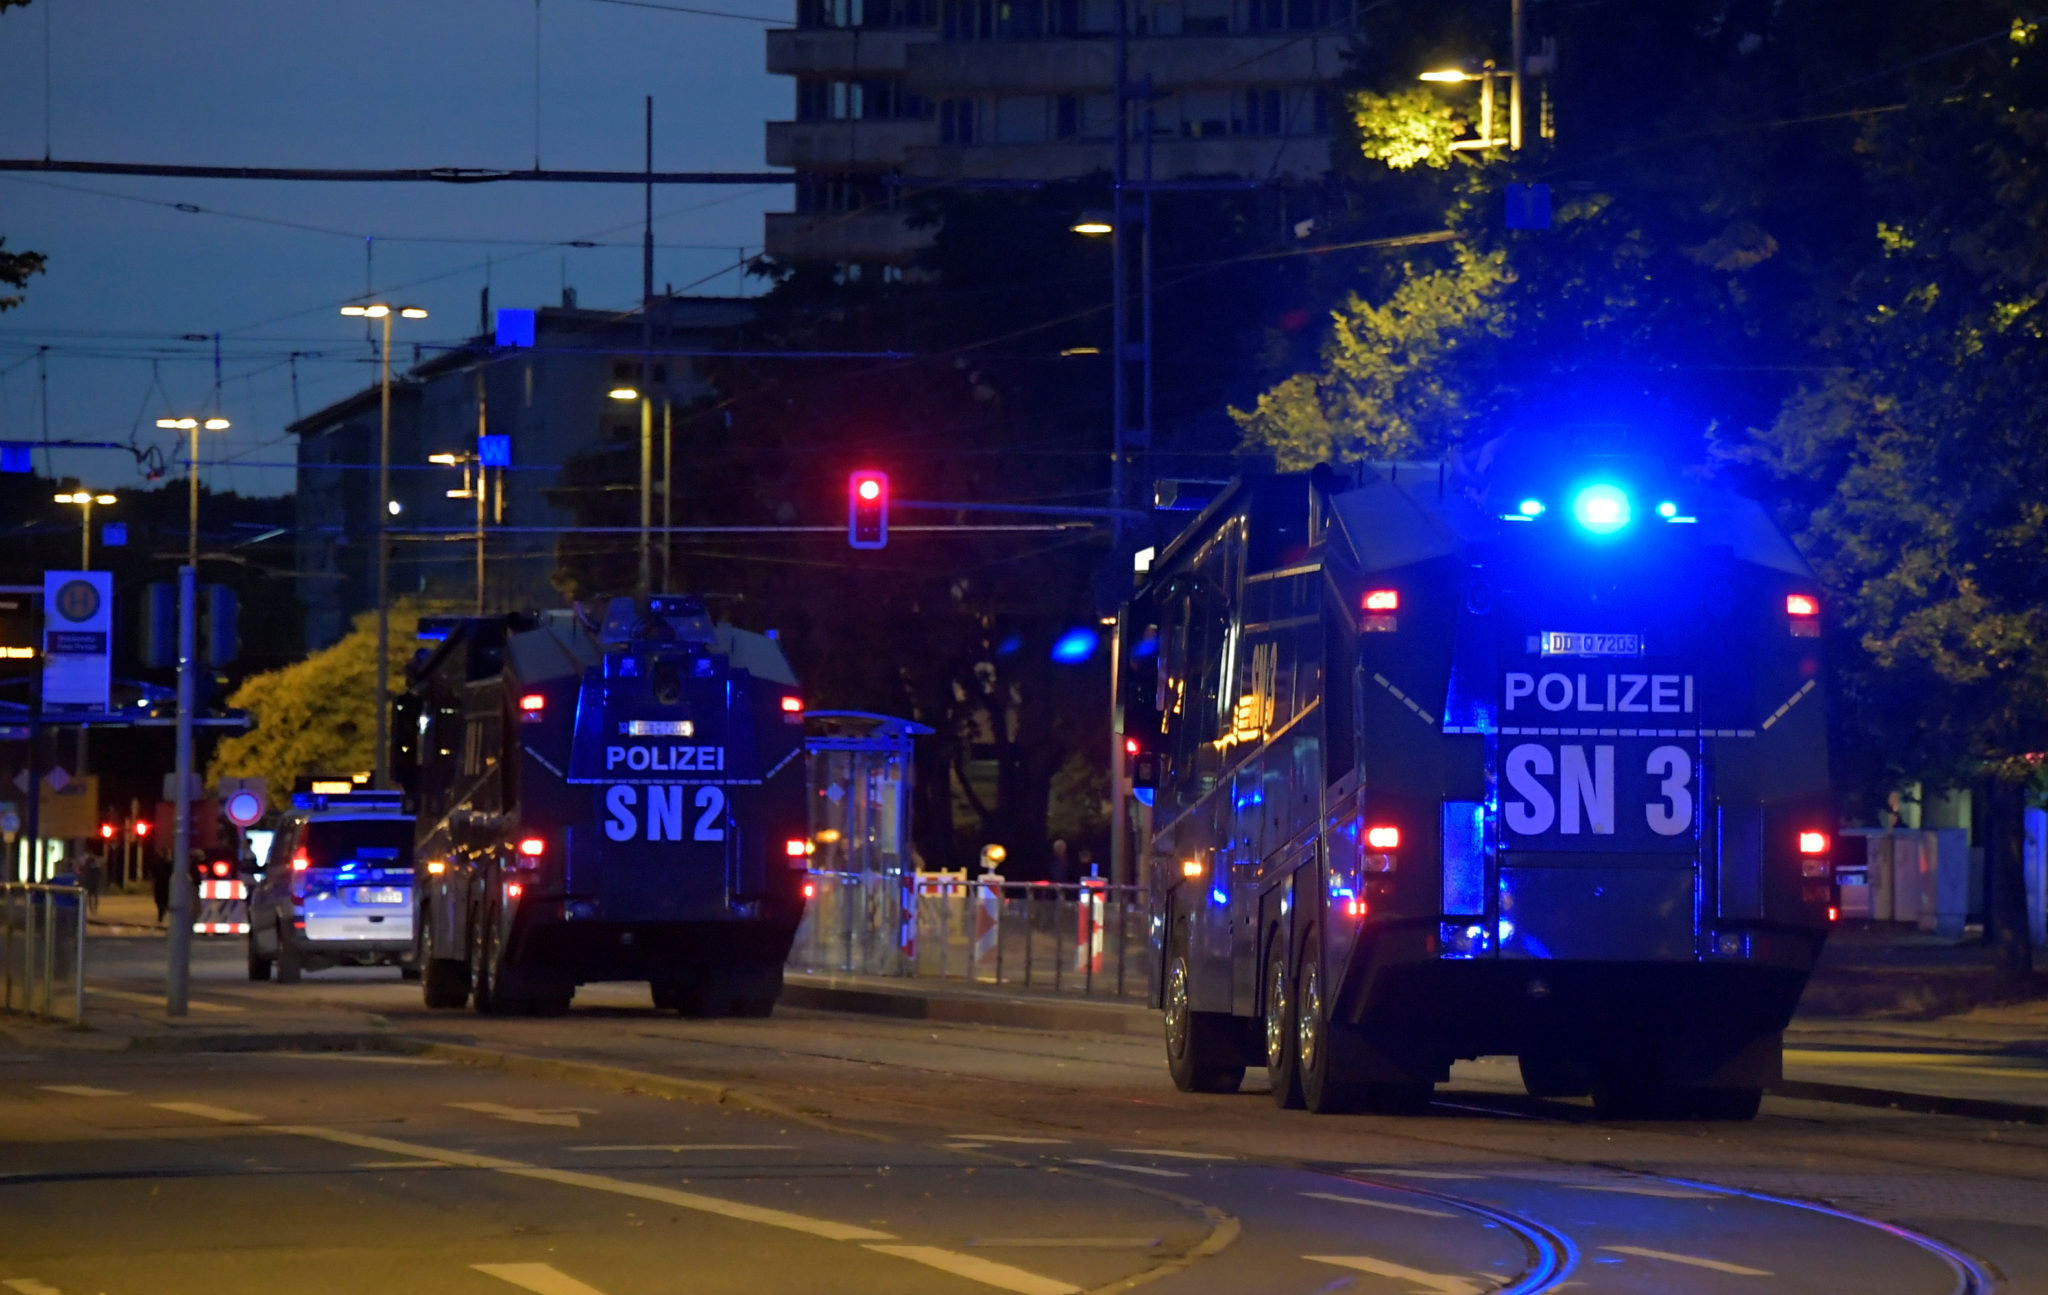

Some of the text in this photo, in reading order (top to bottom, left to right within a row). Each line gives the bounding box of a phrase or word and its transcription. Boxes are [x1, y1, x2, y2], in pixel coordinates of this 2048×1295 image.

[481, 439, 506, 461] W
[1553, 635, 1572, 651] DD
[1504, 673, 1694, 713] POLIZEI
[606, 745, 725, 771] POLIZEI
[1504, 743, 1693, 836] SN 3
